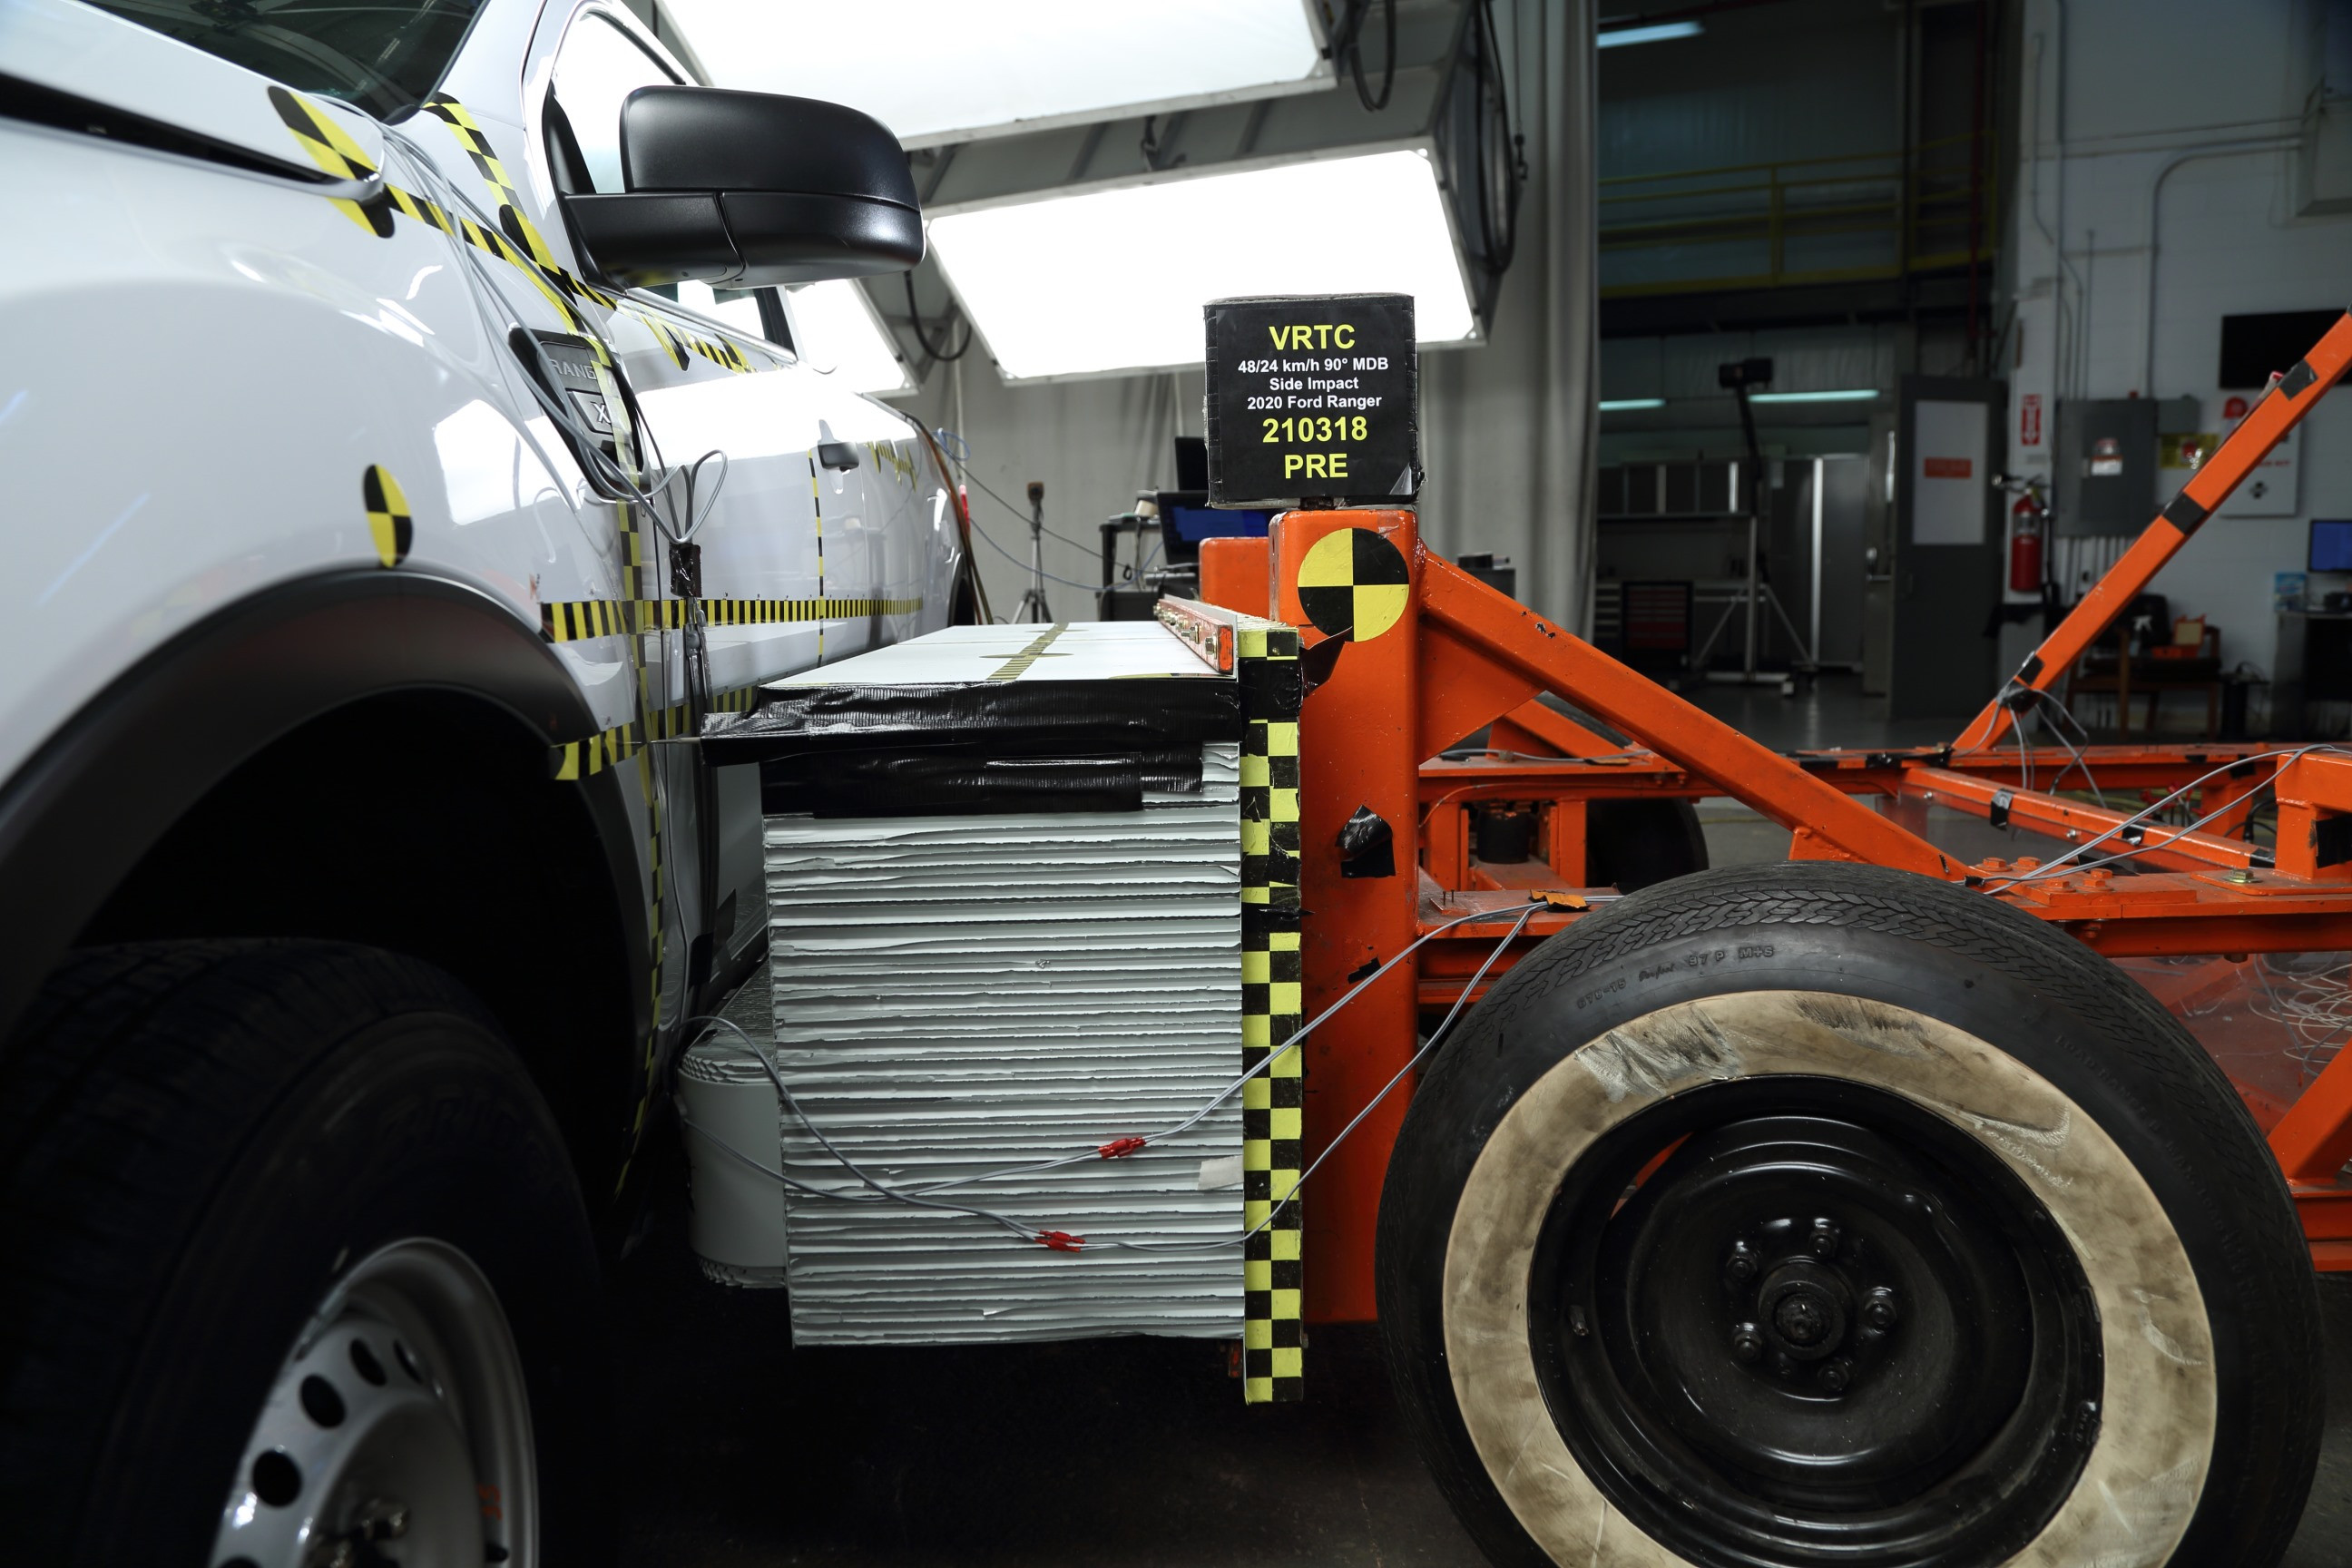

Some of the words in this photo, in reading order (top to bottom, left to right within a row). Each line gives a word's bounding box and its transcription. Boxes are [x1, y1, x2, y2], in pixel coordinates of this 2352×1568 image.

[1269, 324, 1355, 350] VRTC
[548, 358, 598, 379] RANG
[1238, 359, 1279, 373] 48/24
[1282, 358, 1319, 372] km/h
[1324, 358, 1348, 371] 90°
[1353, 357, 1388, 371] MDB
[1269, 377, 1303, 391] Side
[1308, 377, 1358, 392] Impact
[590, 401, 612, 425] X
[1247, 397, 1282, 409] 2020
[1288, 396, 1322, 408] Ford
[1327, 396, 1382, 410] Ranger
[1262, 416, 1367, 443] 210318
[1284, 453, 1348, 479] PRE
[1739, 946, 1774, 959] M+S
